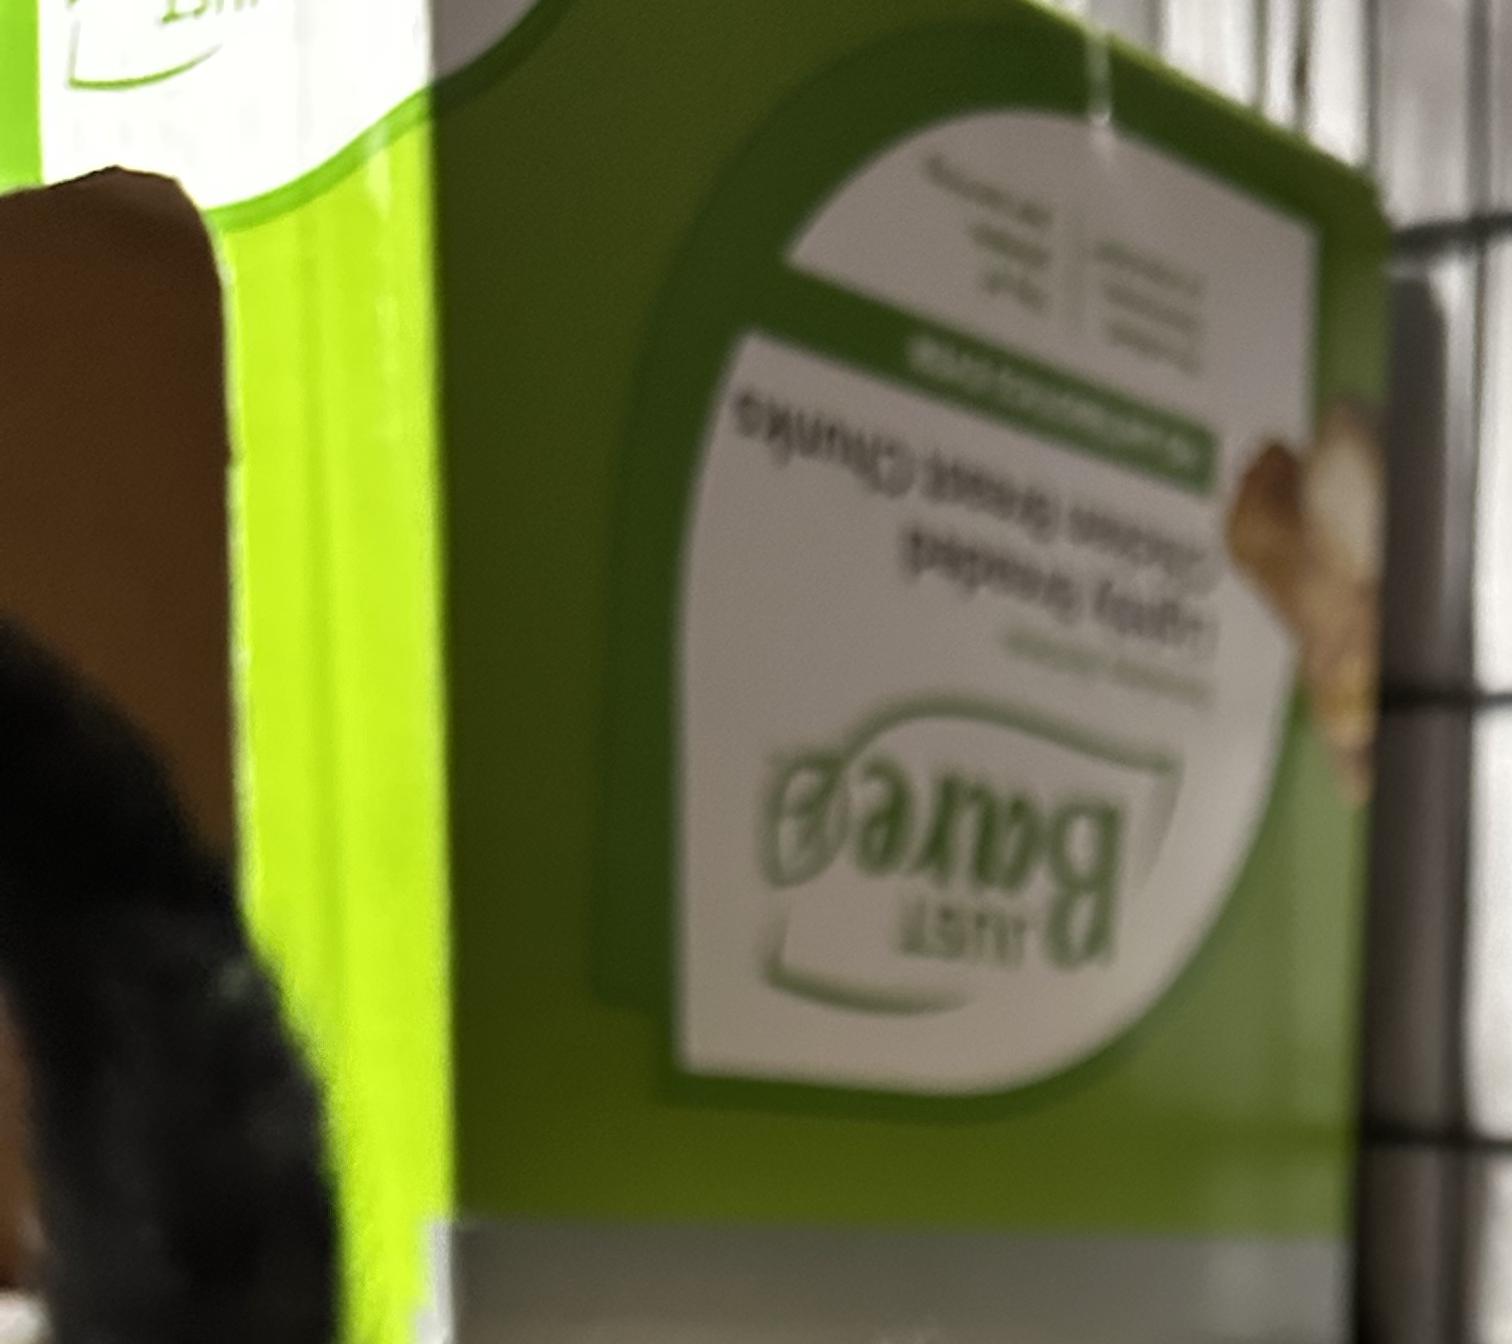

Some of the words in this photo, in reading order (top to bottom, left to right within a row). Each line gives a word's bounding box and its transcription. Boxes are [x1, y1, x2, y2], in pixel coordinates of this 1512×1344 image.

[732, 392, 915, 499] Chunks
[854, 762, 1122, 970] Bare
[897, 902, 1029, 969] JUST
